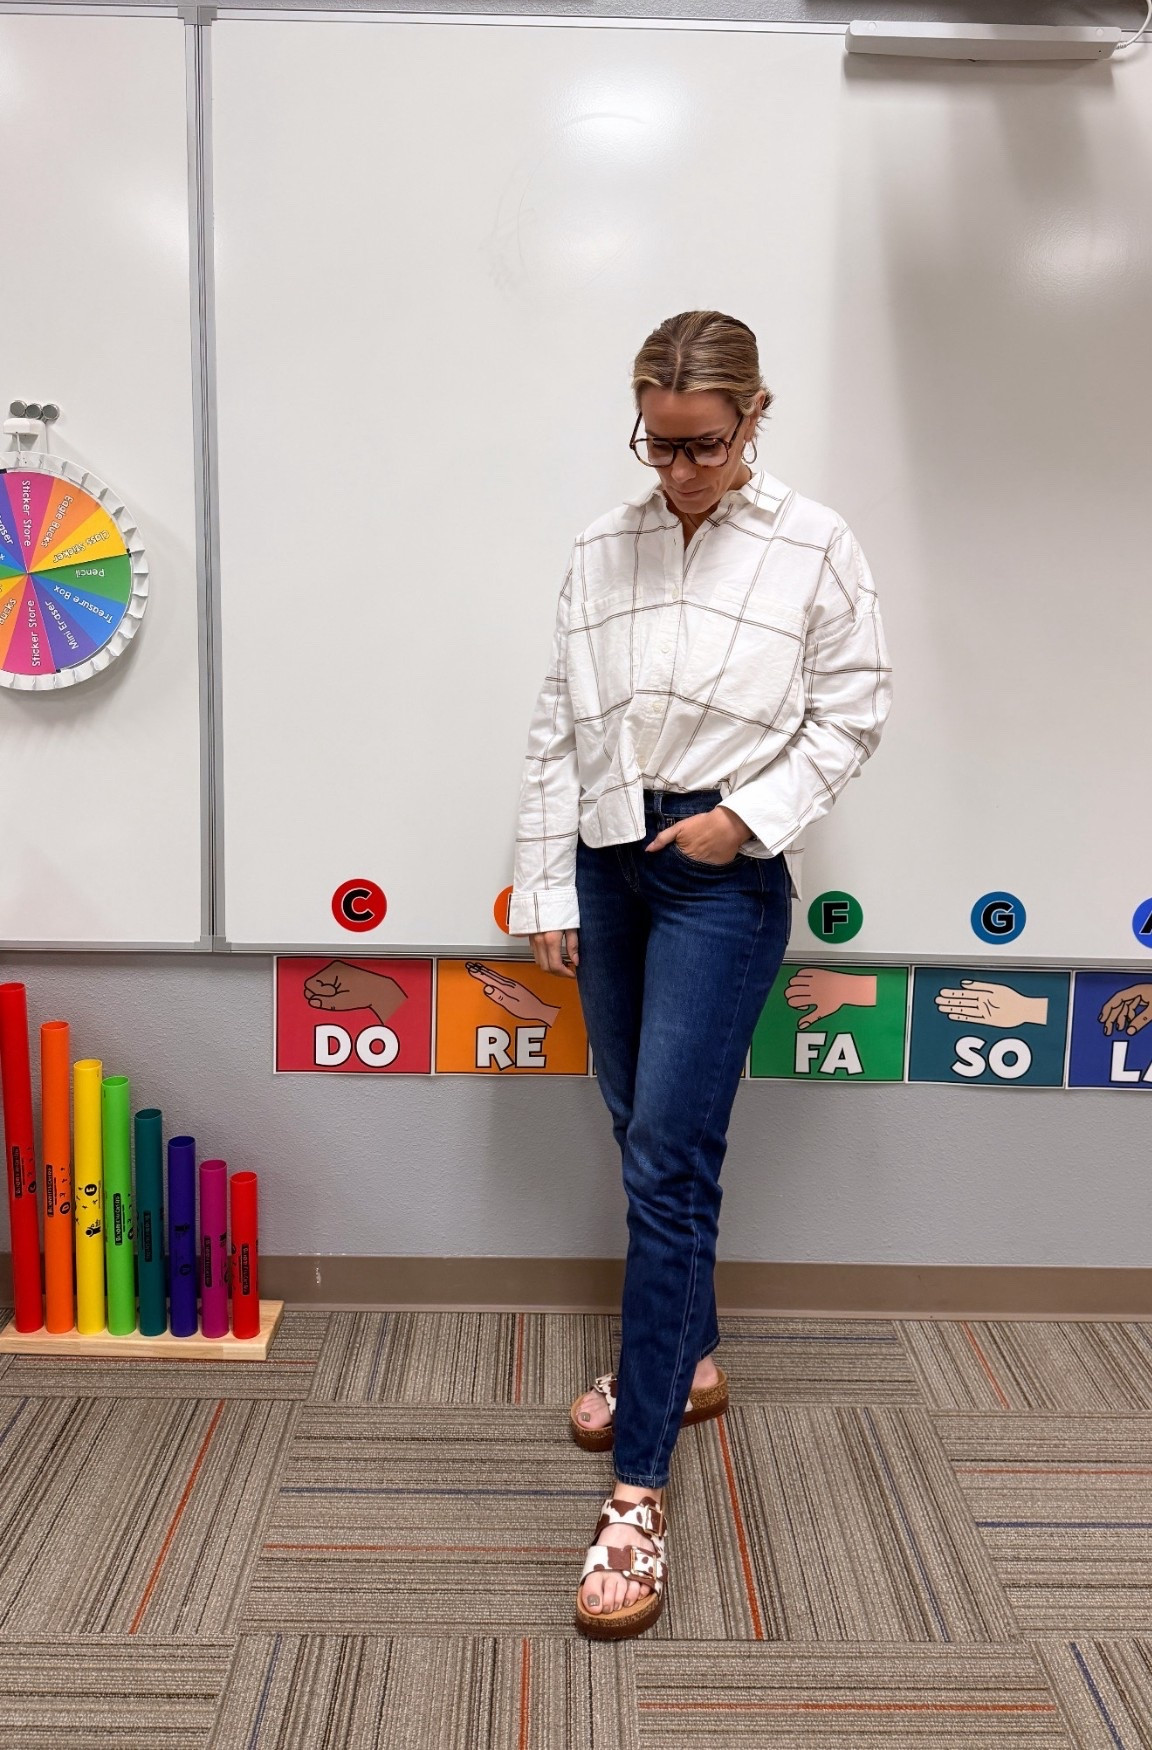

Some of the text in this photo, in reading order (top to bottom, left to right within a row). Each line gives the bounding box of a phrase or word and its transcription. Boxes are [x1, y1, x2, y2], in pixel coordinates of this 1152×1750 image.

[22, 480, 32, 547] Sticker Store
[41, 495, 74, 549] Eagle Bucks
[53, 530, 111, 563] Class Sticker
[75, 567, 106, 578] Pencil
[45, 600, 80, 651] Mini Eraser
[53, 584, 114, 625] Treasure Box
[27, 600, 42, 668] Sticker Store
[342, 888, 375, 922] C
[822, 901, 850, 935] F
[981, 900, 1016, 935] G
[314, 1024, 400, 1068] DO
[476, 1025, 548, 1071] RE
[793, 1031, 864, 1075] FA
[950, 1035, 1032, 1080] SO
[1110, 1039, 1152, 1083] L
